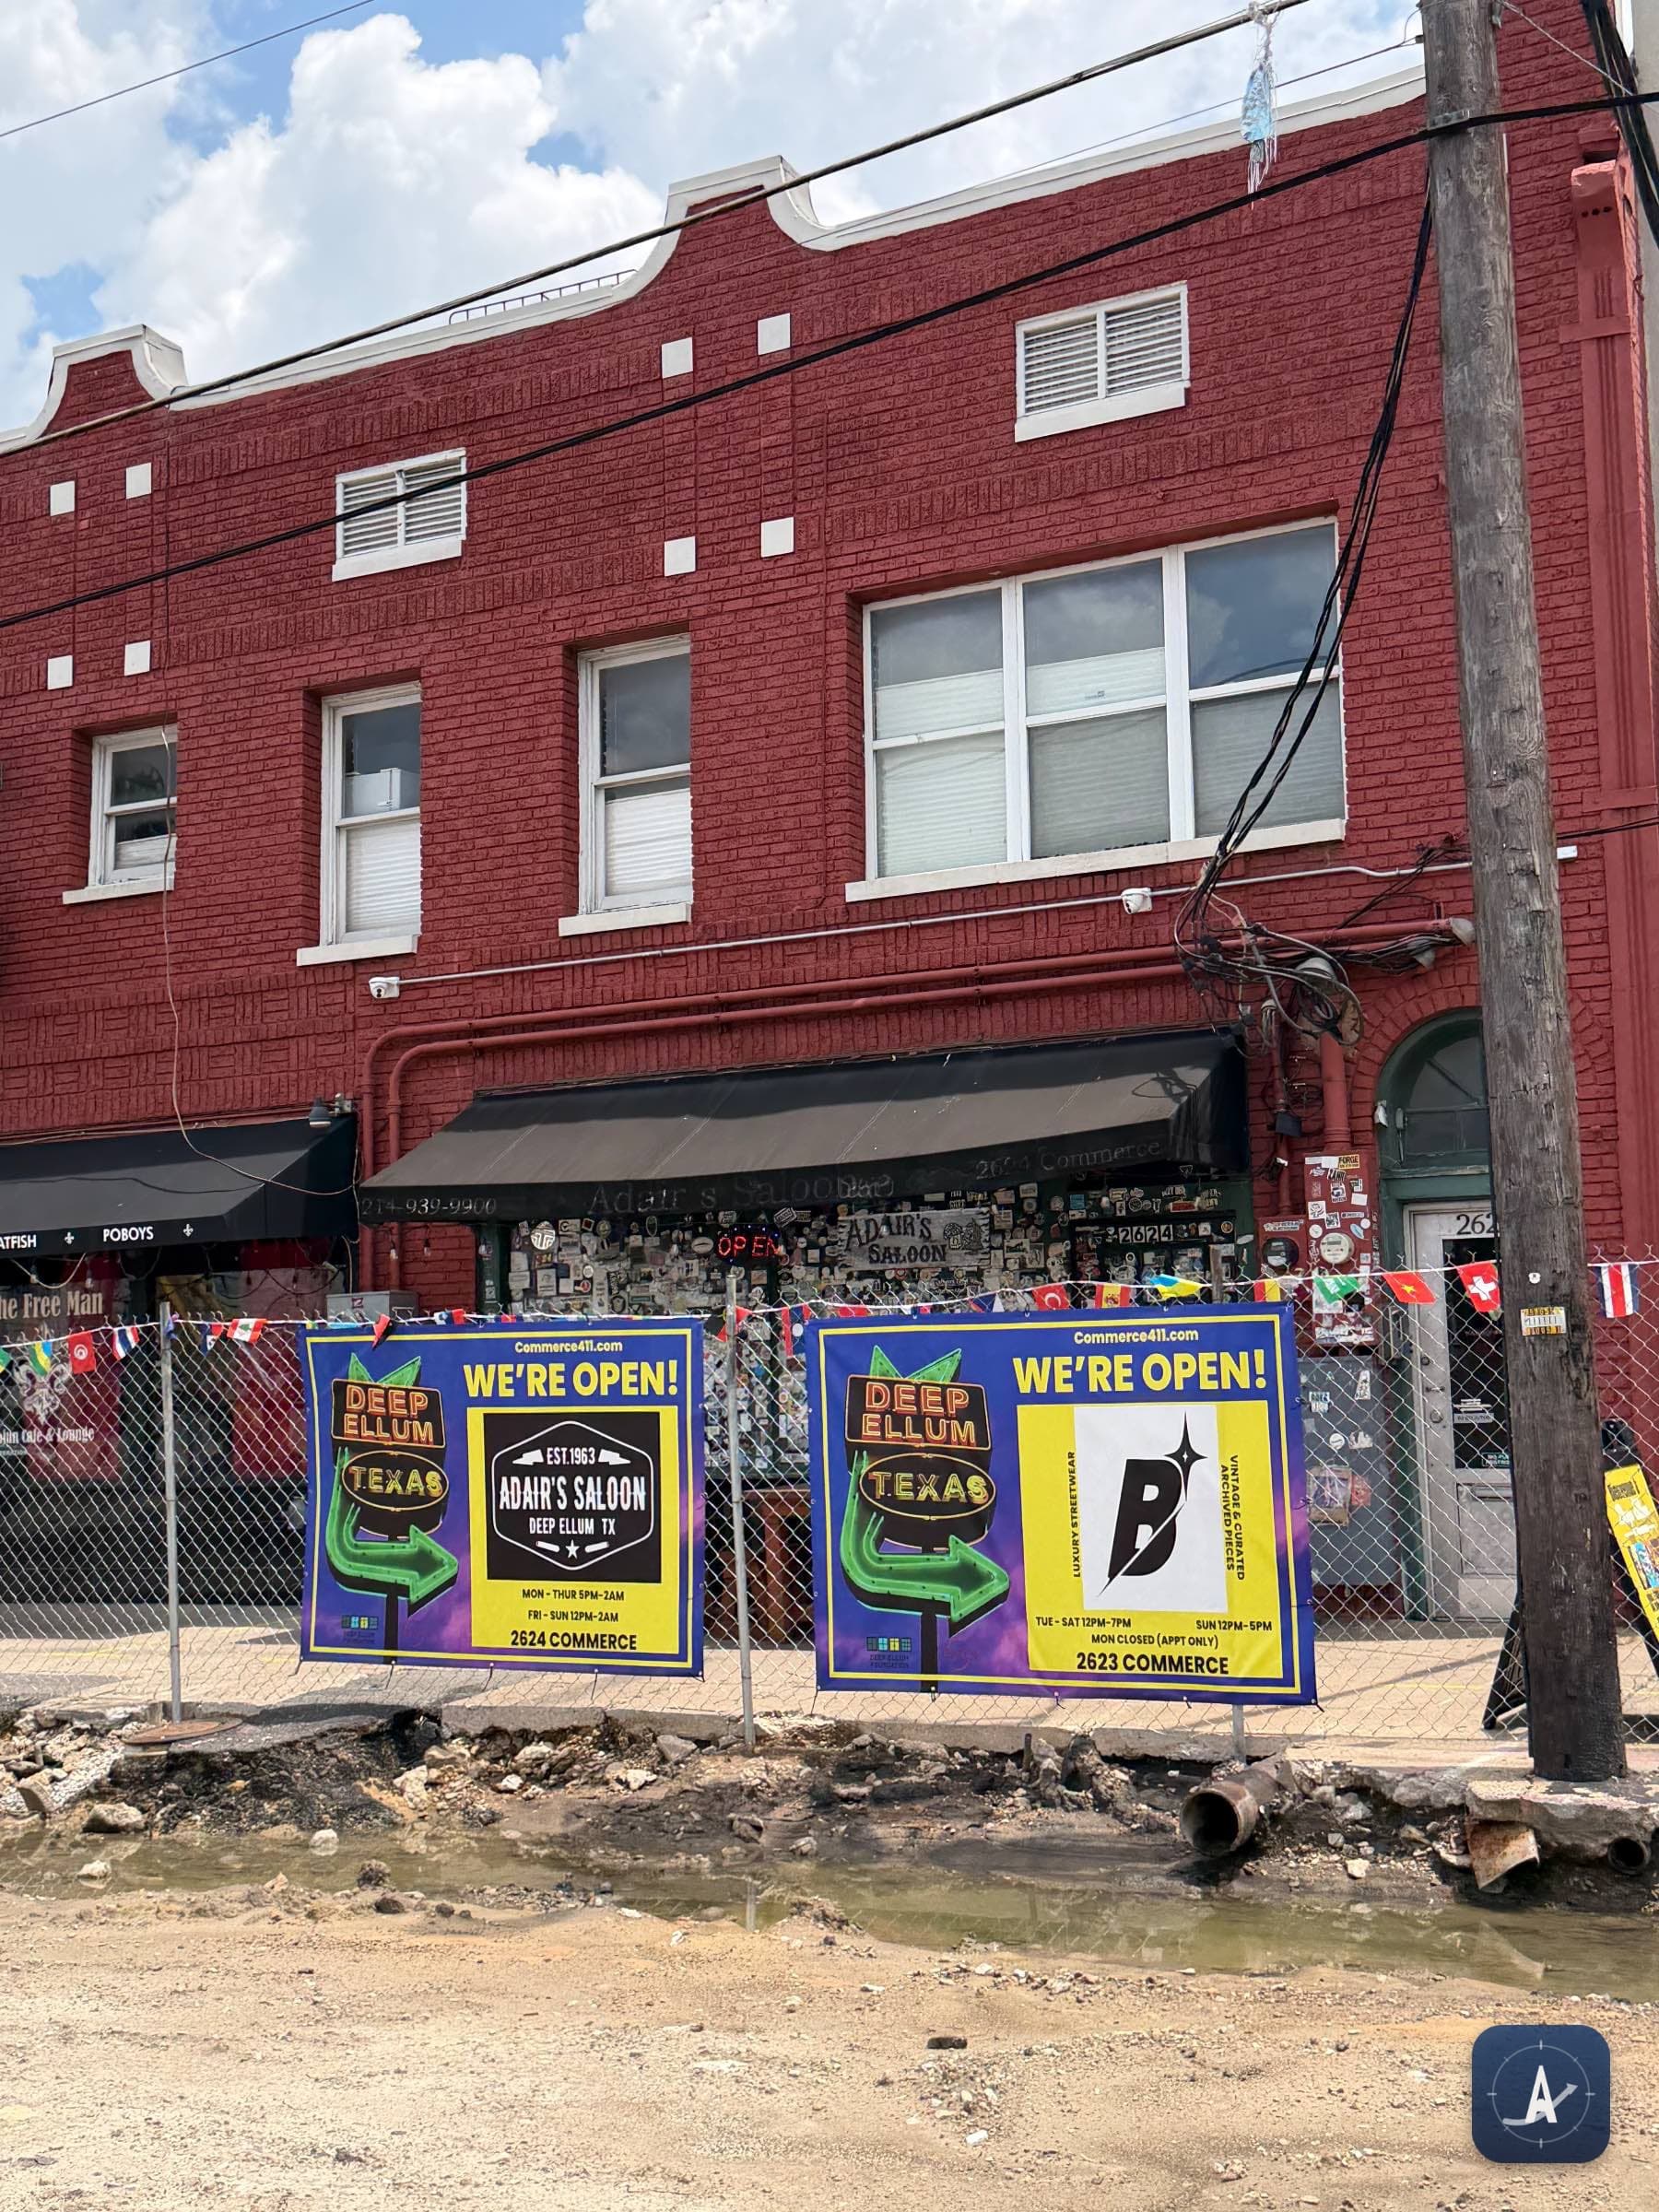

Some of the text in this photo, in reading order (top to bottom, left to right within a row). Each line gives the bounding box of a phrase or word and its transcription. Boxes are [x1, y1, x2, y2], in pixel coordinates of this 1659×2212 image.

[1040, 1142, 1160, 1171] Commerce
[361, 1198, 497, 1215] 214-939-9900
[589, 1183, 716, 1215] Adairs
[102, 1226, 154, 1242] POBOYS
[845, 1213, 932, 1251] ADAIR'S
[1120, 1226, 1172, 1242] 2624
[718, 1235, 781, 1257] OPEN
[868, 1244, 947, 1264] SALOON
[22, 1293, 61, 1319] Free
[66, 1290, 103, 1316] Man
[514, 1339, 623, 1354] Commerce411.com
[1074, 1328, 1199, 1345] Commerce411.com
[464, 1359, 678, 1397] WE'RE OPEN!
[1013, 1348, 1267, 1394] WE'RE OPEN!
[346, 1384, 429, 1418] DEEP
[865, 1381, 970, 1417] DEEP
[57, 1426, 95, 1443] Lounge
[344, 1413, 434, 1445] ELLUM
[862, 1413, 976, 1447] ELLUM
[348, 1465, 443, 1498] TEXAS
[499, 1476, 646, 1511] ADAIR'S SALOON
[867, 1471, 989, 1505] TEXAS
[529, 1517, 616, 1535] DEEP ELLUM TX
[1067, 1452, 1081, 1578] LUXURY STREETWEAR
[1221, 1465, 1235, 1571] ARCHIVED PIECES
[1230, 1454, 1245, 1581] VINTAGE & CURATED
[523, 1588, 545, 1599] MON
[553, 1589, 577, 1600] THUR
[579, 1590, 625, 1601] 5PM-2AM
[528, 1610, 542, 1620] FRI
[550, 1611, 569, 1621] SUN
[571, 1611, 618, 1622] 12PM-2AM
[1036, 1617, 1053, 1627] TUE
[1062, 1618, 1080, 1628] SAT
[1082, 1618, 1132, 1629] 12PM-7PM
[1195, 1619, 1272, 1631] SUN 12PM-5PM
[511, 1630, 637, 1650] 2624 COMMERCE
[1091, 1632, 1219, 1650] MON CLOSED (APPT ONLY)
[1077, 1652, 1229, 1675] 2623 COMMERCE
